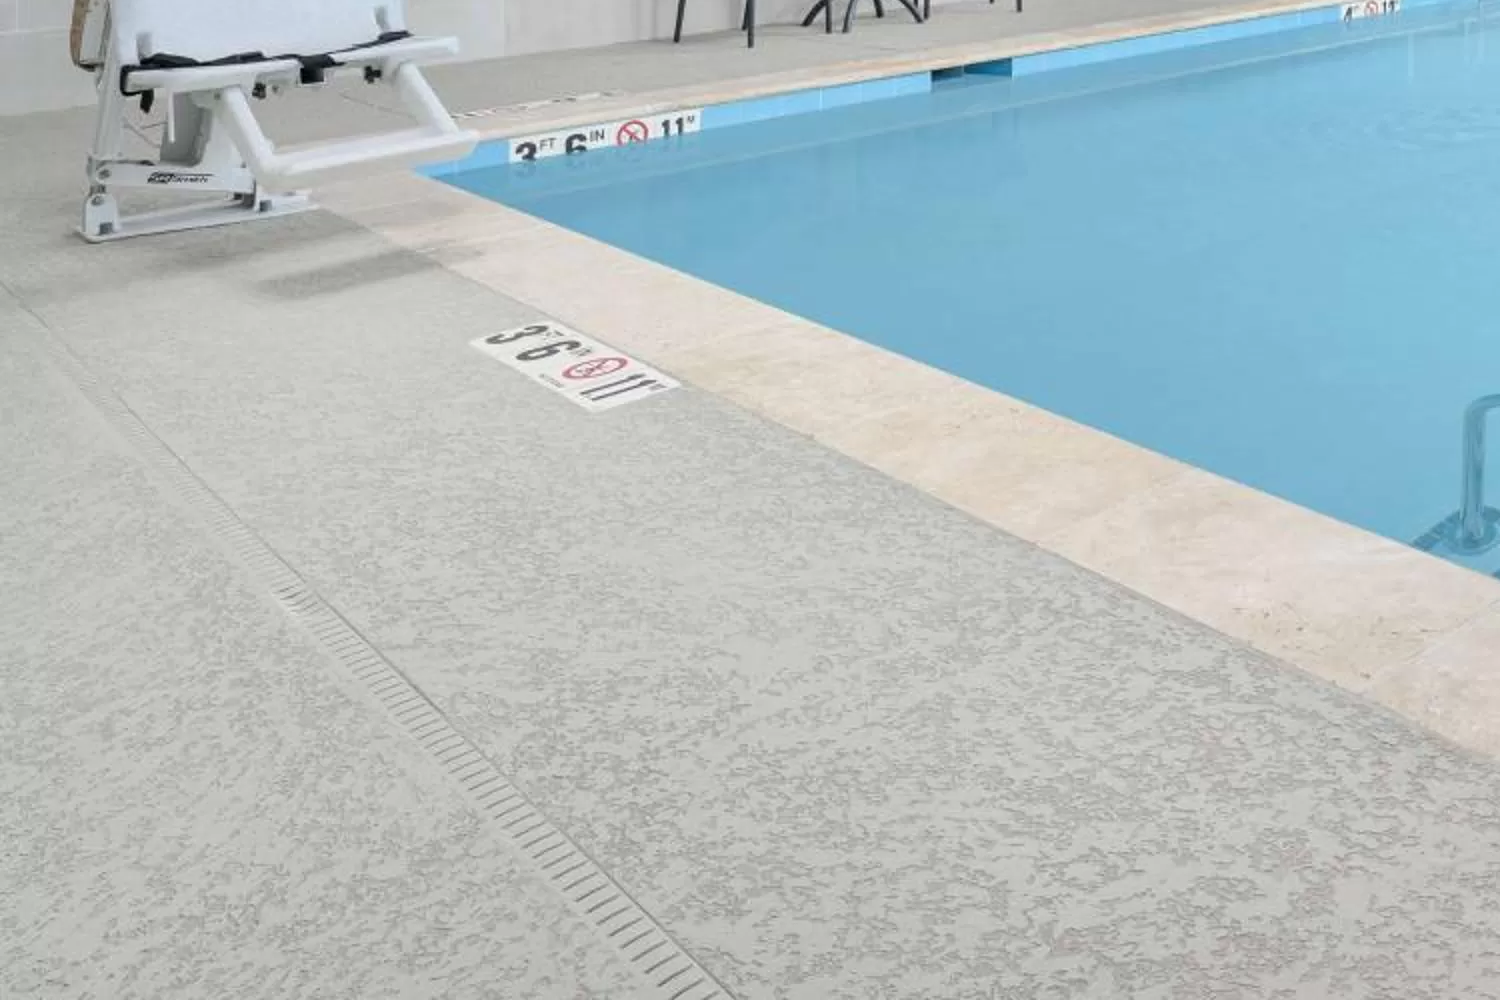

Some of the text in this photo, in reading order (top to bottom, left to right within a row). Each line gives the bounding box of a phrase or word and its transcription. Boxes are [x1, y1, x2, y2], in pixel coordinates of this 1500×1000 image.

[565, 133, 588, 154] 6
[590, 128, 605, 142] IN
[485, 324, 549, 345] 3
[516, 340, 581, 361] 6
